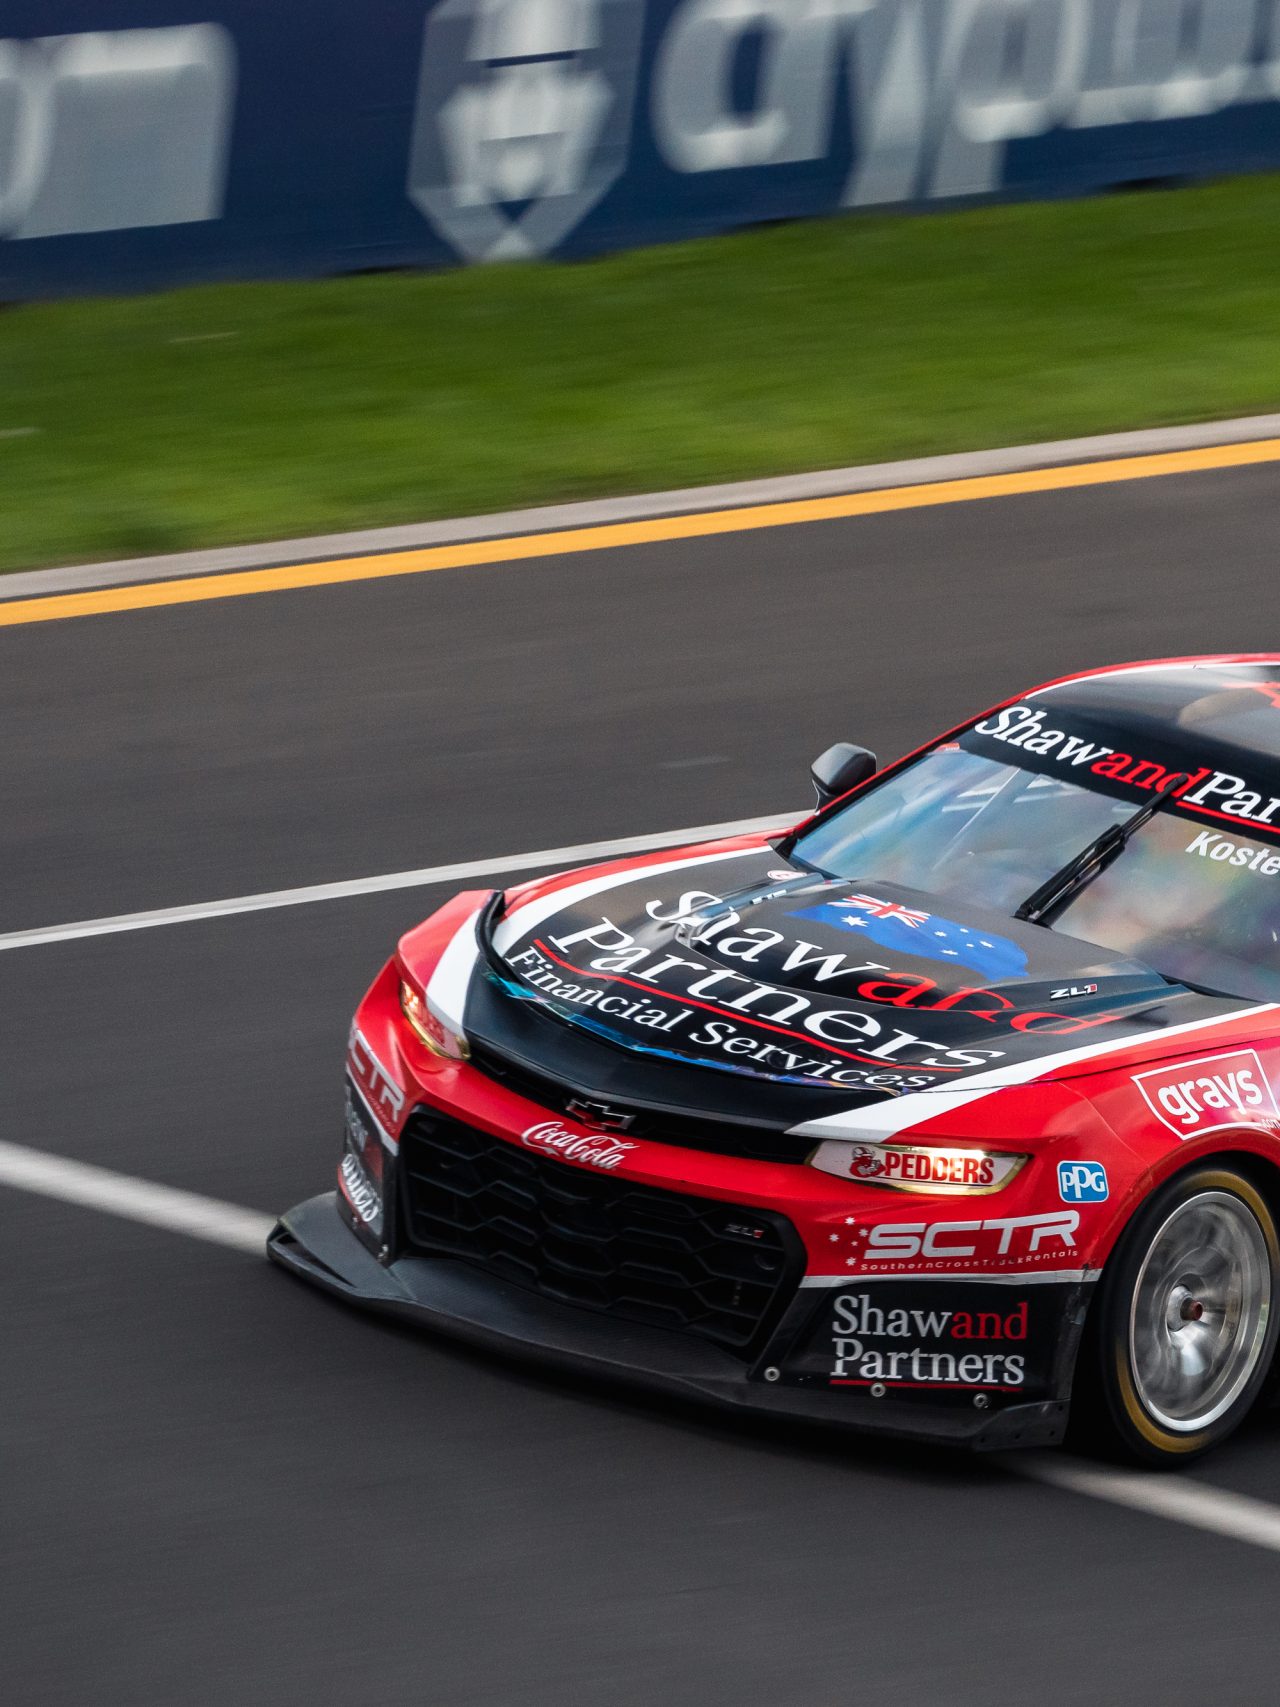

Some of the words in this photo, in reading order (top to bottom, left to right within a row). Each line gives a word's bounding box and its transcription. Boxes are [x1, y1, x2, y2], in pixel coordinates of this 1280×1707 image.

[547, 916, 1006, 1068] Partners
[1050, 983, 1098, 999] ZL1
[504, 946, 695, 1032] Financial
[688, 1021, 936, 1088] Services
[1157, 1069, 1263, 1125] grays
[884, 1151, 995, 1184] PEDDERS
[1061, 1165, 1106, 1199] PPG
[863, 1209, 1081, 1260] SCTR
[830, 1337, 1025, 1385] Partners
